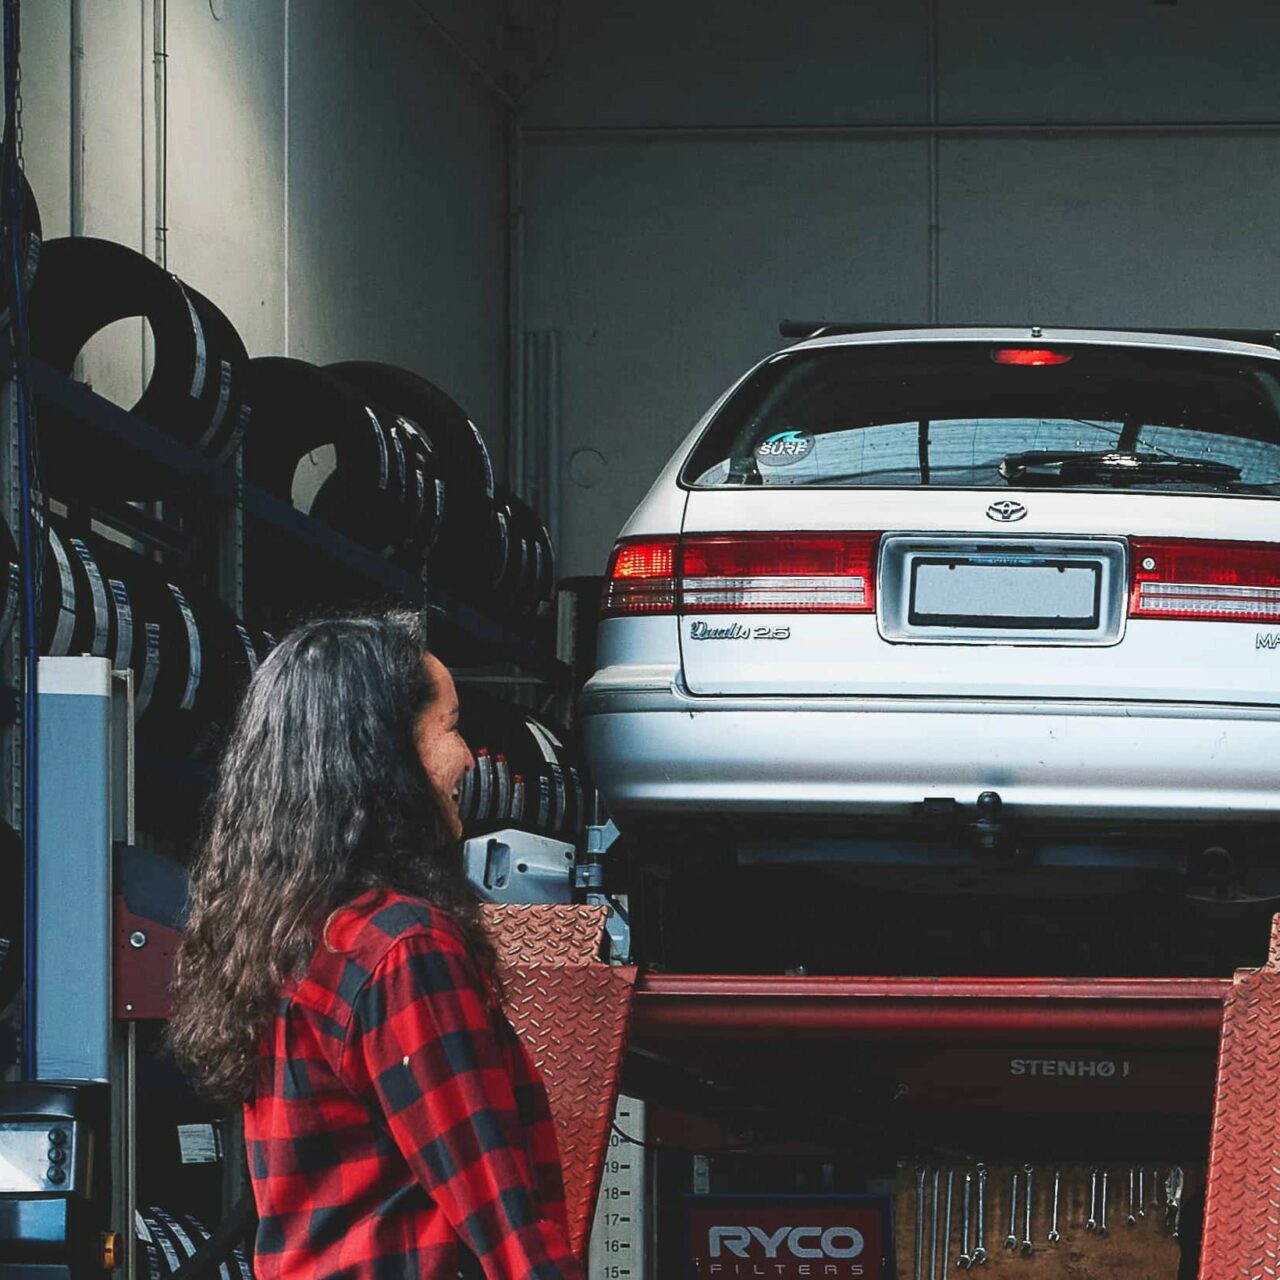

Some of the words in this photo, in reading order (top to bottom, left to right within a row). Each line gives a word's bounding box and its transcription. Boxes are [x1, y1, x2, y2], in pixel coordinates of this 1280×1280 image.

[759, 444, 808, 455] SURF
[604, 1161, 620, 1174] 19
[604, 1187, 620, 1200] 18
[604, 1213, 620, 1226] 17
[604, 1239, 620, 1253] 16
[708, 1226, 864, 1258] RYCO
[604, 1266, 620, 1279] 15
[710, 1264, 865, 1275] FILTERS
